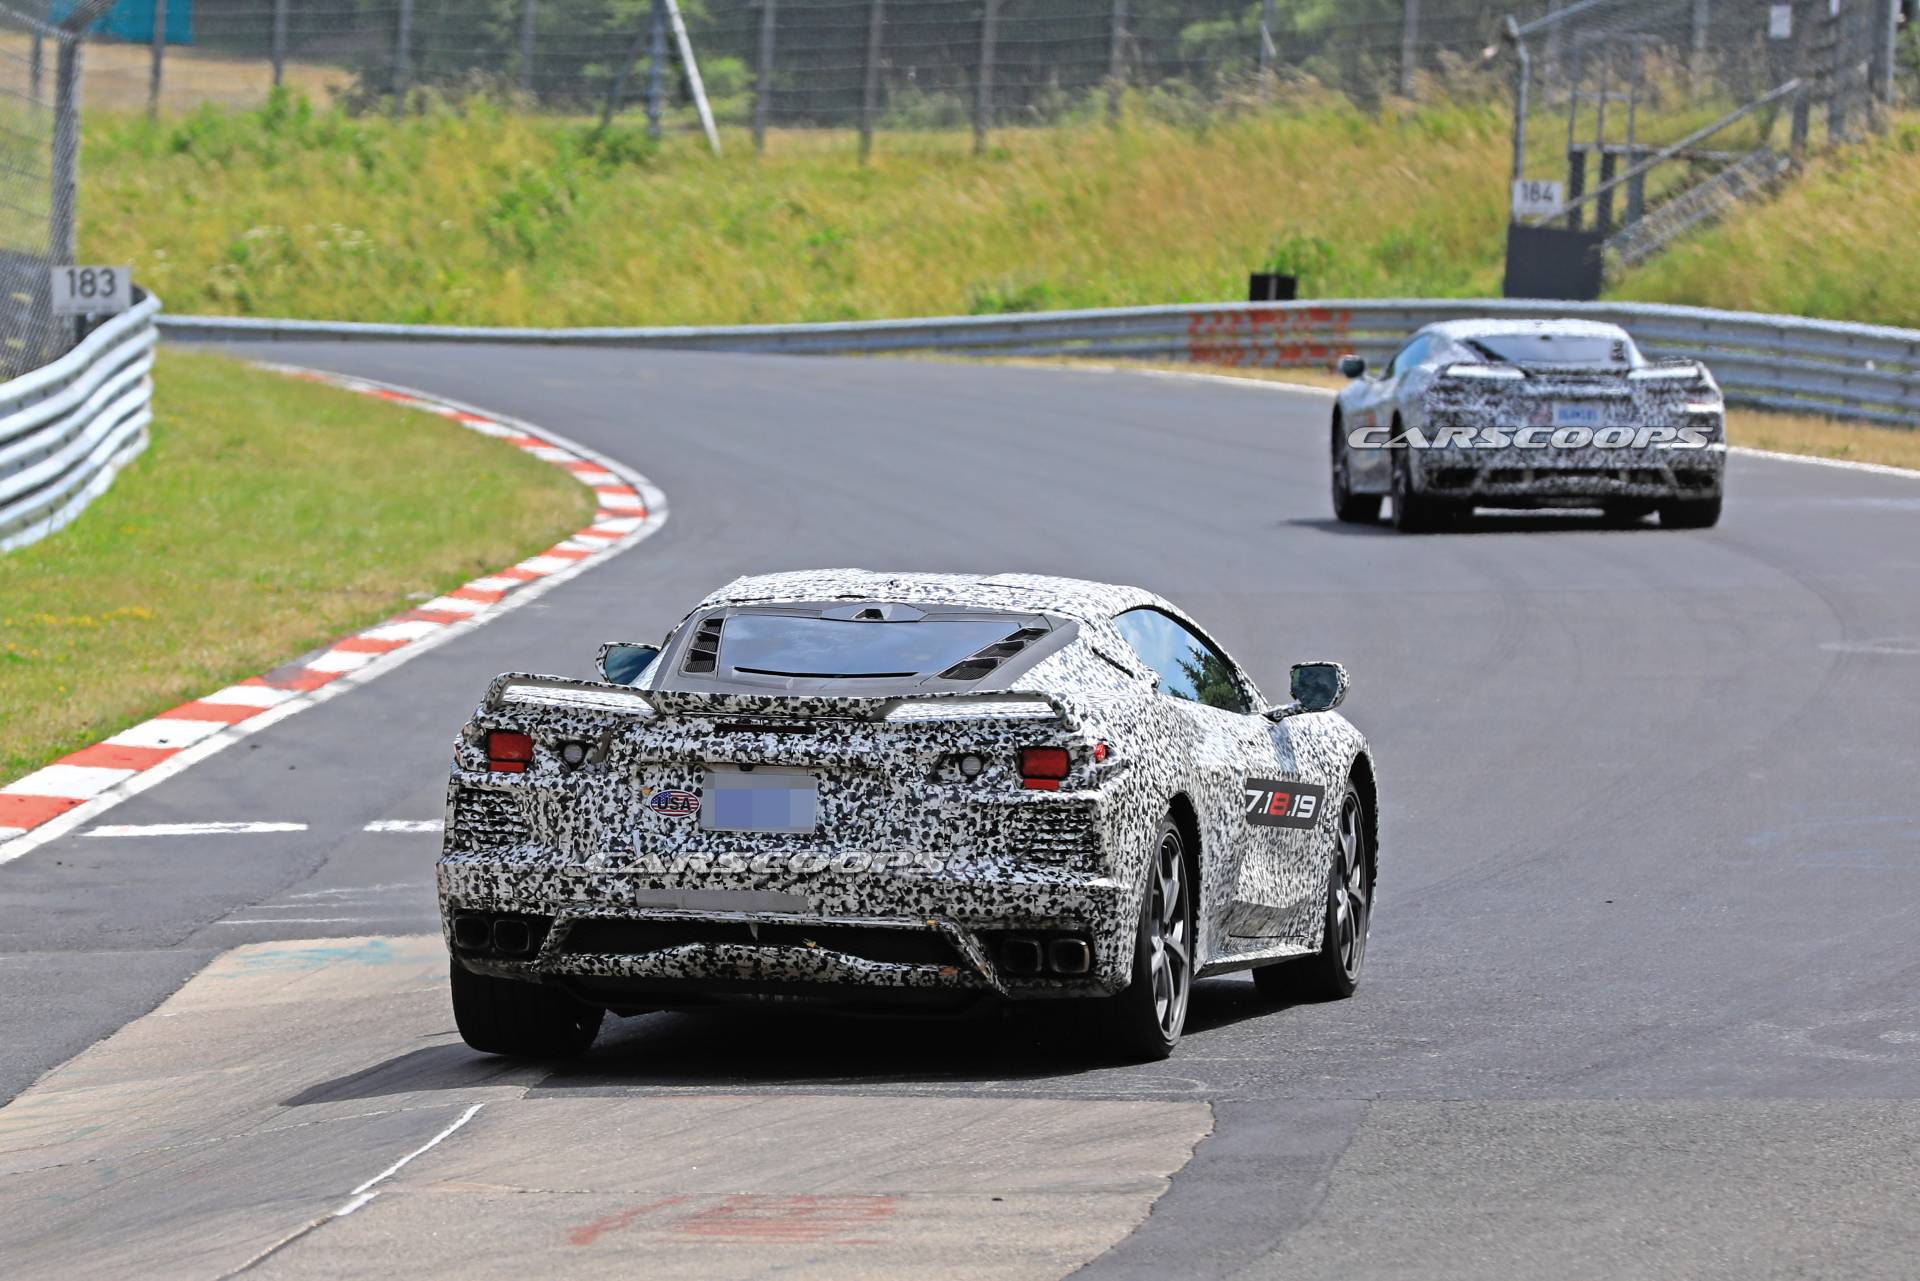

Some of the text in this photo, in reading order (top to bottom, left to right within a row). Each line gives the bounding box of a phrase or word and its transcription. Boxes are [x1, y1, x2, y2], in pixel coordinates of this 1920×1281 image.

[66, 268, 115, 298] 183
[657, 796, 691, 811] USA
[1246, 789, 1317, 819] 7.18.19
